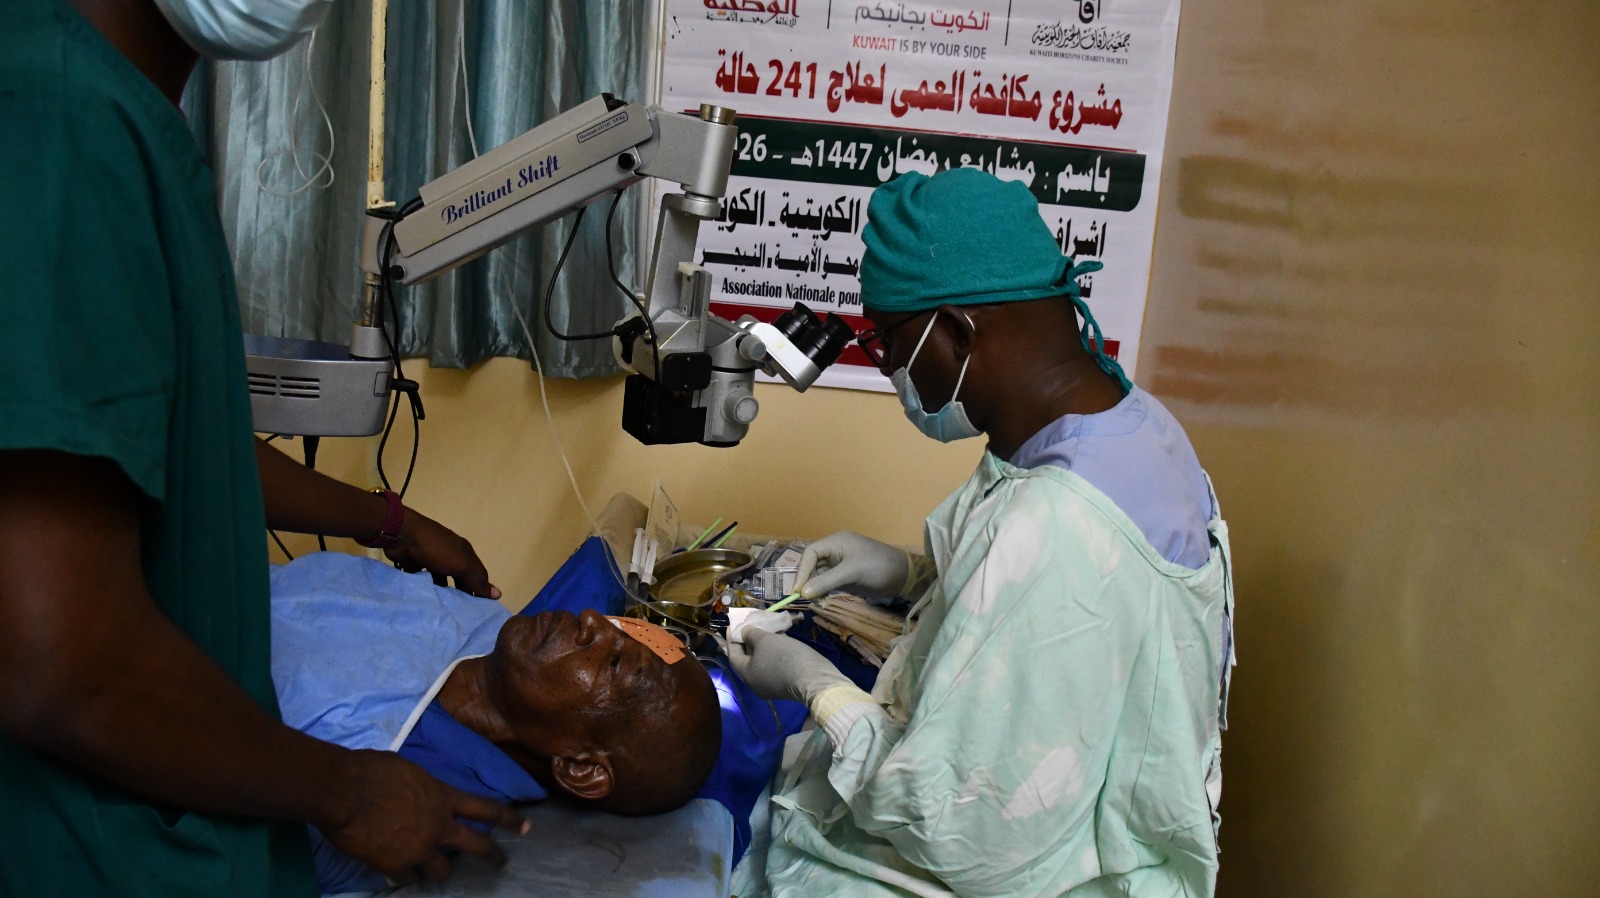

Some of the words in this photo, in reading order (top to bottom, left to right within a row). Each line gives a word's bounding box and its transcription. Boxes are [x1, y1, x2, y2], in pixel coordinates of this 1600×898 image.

[855, 2, 926, 31] بجانبكم
[931, 9, 990, 33] الكويت
[853, 35, 897, 51] KUWAIT
[900, 40, 909, 52] IS
[912, 41, 927, 54] BY
[930, 42, 960, 57] YOUR
[964, 45, 987, 60] SIDE
[1029, 49, 1053, 58] KUWAITI
[1053, 51, 1081, 61] HORIZONS
[1081, 53, 1105, 63] CHARITY
[1106, 56, 1128, 65] SOCIETY
[715, 49, 760, 94] حالة
[766, 59, 818, 99] 241
[827, 60, 886, 113] لعلاج
[890, 68, 965, 118] العمى
[969, 70, 1043, 122] مكافحة
[1049, 83, 1123, 135] مشروع
[734, 132, 767, 162] 26
[441, 178, 515, 225] Brilliant
[518, 155, 561, 188] Shift
[1056, 155, 1110, 203] باسم
[700, 188, 765, 232] الكوي
[780, 191, 861, 241] الكويتية
[699, 242, 766, 272] النيجر
[775, 241, 822, 277] الأمية
[821, 254, 861, 283] محو
[722, 277, 782, 298] Association
[786, 282, 835, 304] Nationale
